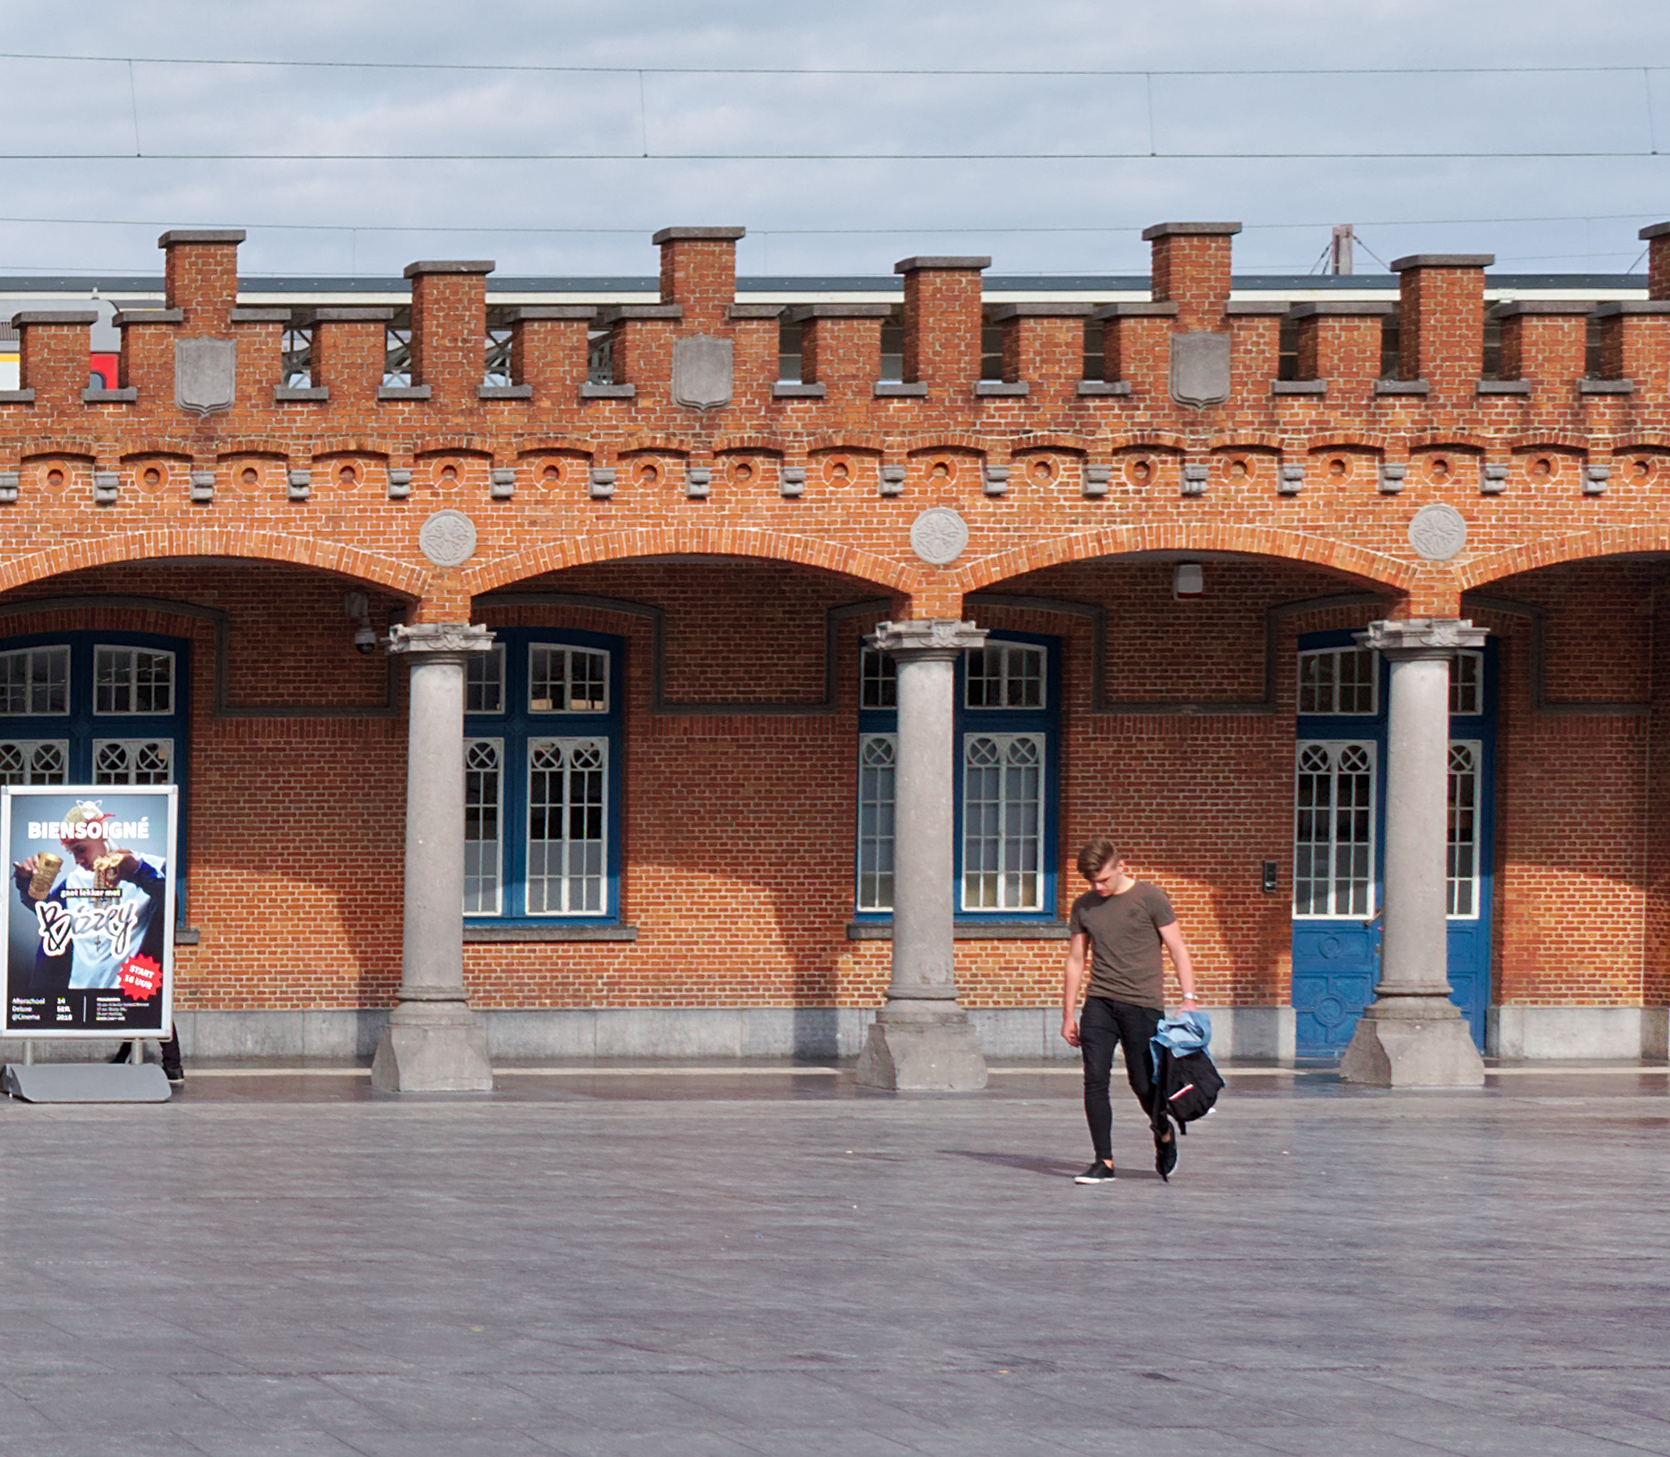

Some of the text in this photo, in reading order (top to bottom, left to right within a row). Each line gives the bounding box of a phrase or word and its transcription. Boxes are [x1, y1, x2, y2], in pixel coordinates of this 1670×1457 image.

[28, 817, 150, 840] BIENSOIGNÉ
[36, 901, 137, 958] Bizzey
[129, 964, 155, 979] START
[124, 974, 153, 990] 16 UUR
